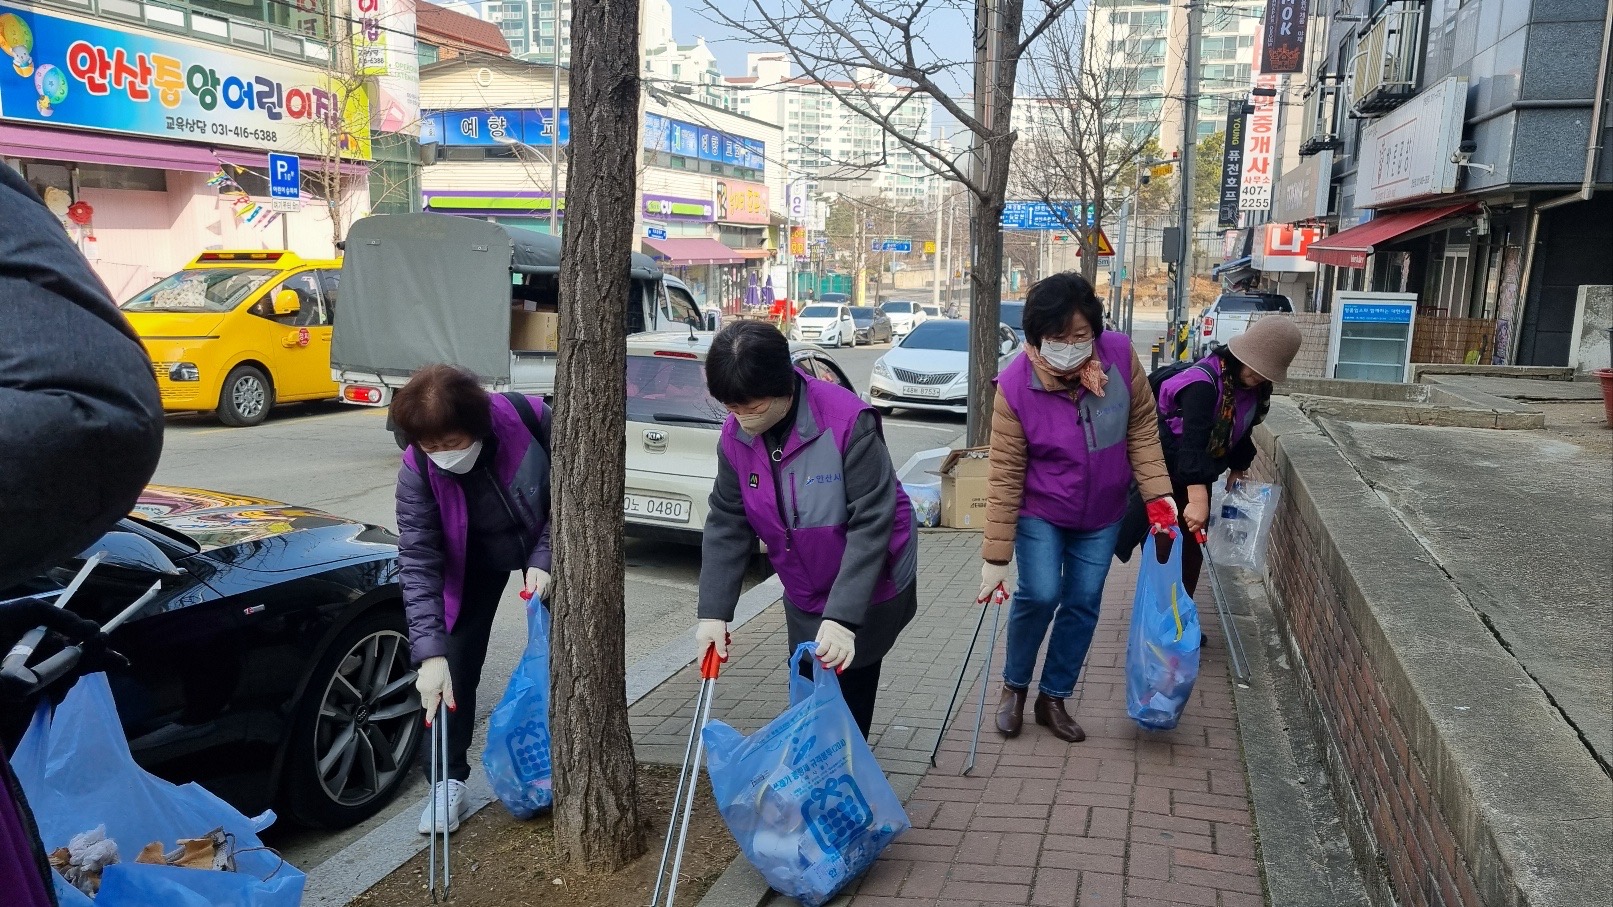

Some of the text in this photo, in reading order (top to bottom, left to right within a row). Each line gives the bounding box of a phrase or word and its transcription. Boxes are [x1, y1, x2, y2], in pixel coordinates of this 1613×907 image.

[68, 42, 339, 130] 안산중앙어린이집
[165, 116, 278, 143] 교육상담 031-416-6388
[1231, 117, 1241, 146] YOUNG
[1224, 150, 1240, 201] 퓨전호프
[1243, 176, 1271, 184] 사무소
[1242, 186, 1267, 196] 407-
[1241, 199, 1269, 208] 2255
[647, 432, 661, 440] KIA
[816, 473, 842, 484] 안산시
[647, 500, 682, 517] 0480
[773, 775, 793, 791] 쓰레기
